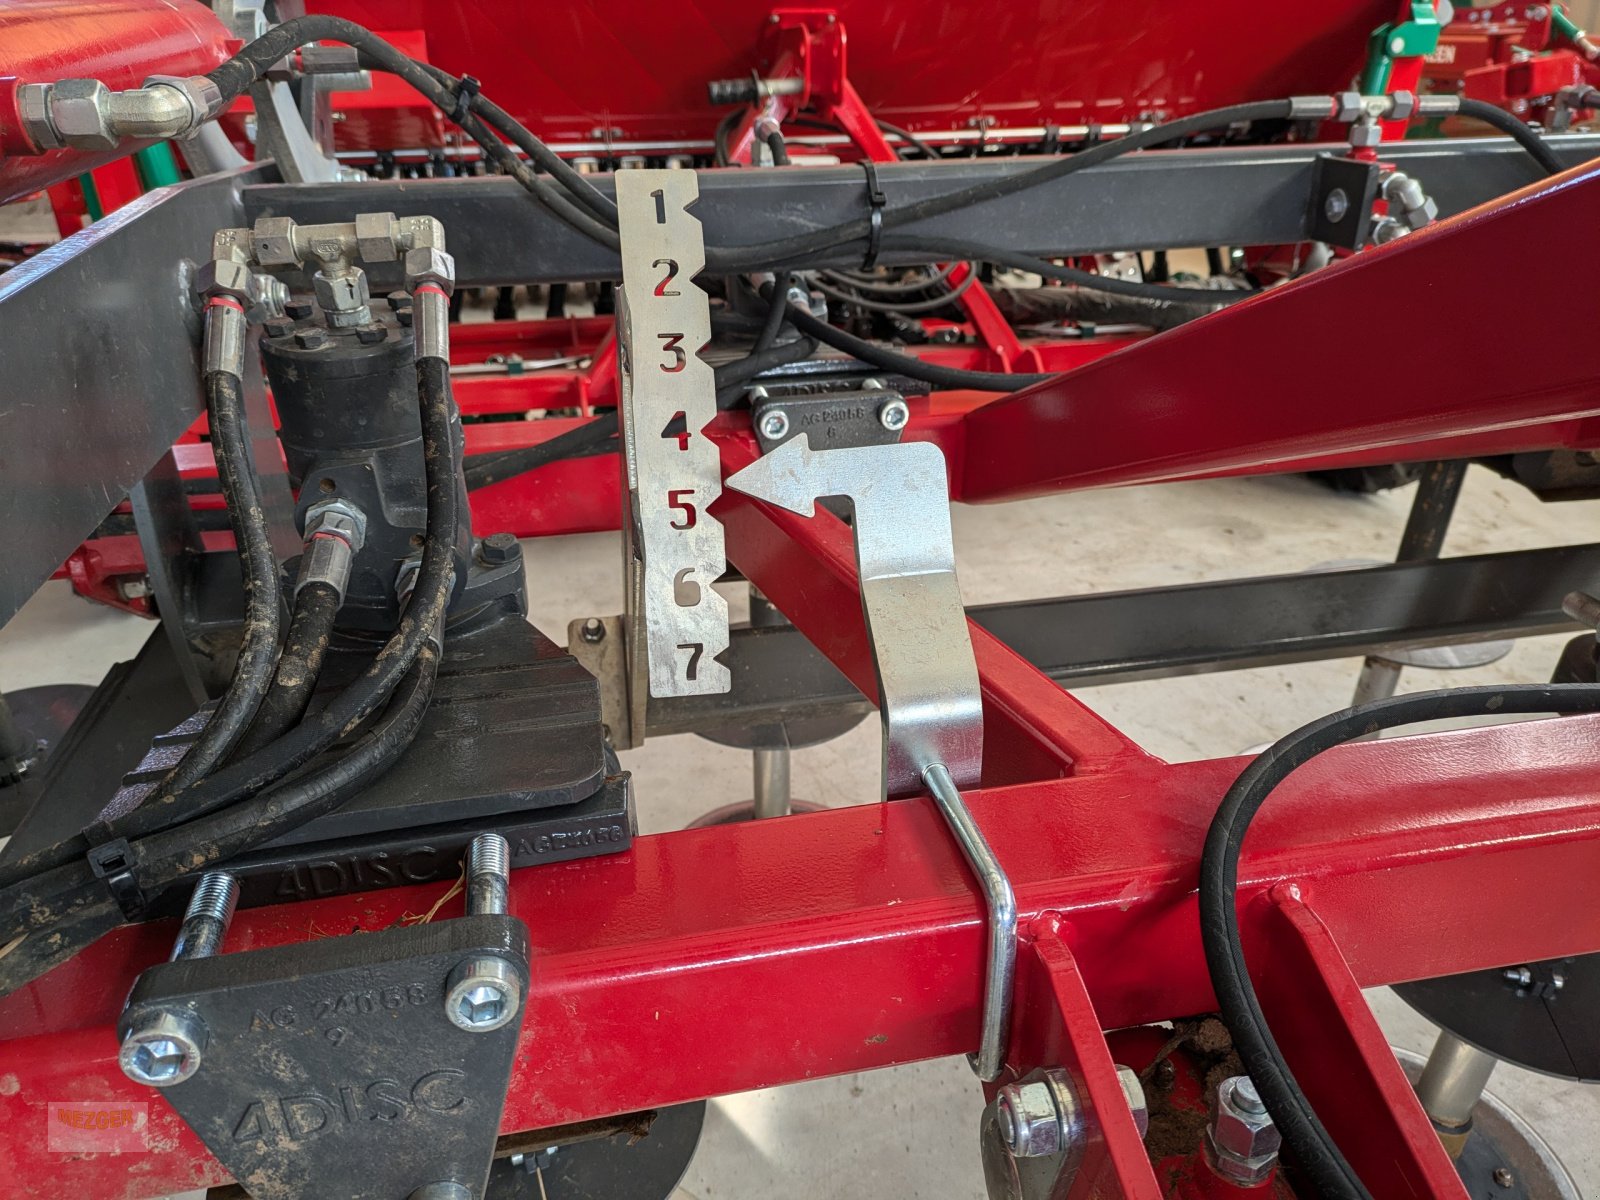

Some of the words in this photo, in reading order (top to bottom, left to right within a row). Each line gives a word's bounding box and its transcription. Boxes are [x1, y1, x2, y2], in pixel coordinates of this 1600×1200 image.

[650, 189, 666, 224] 1
[652, 258, 681, 297] 2
[657, 332, 686, 373] 3
[660, 410, 692, 451] 4
[668, 489, 697, 530] 5
[673, 567, 701, 608] 6
[677, 642, 704, 681] 7
[274, 845, 438, 897] 4DISC
[250, 1004, 297, 1033] AG
[232, 1068, 474, 1146] 4DISC
